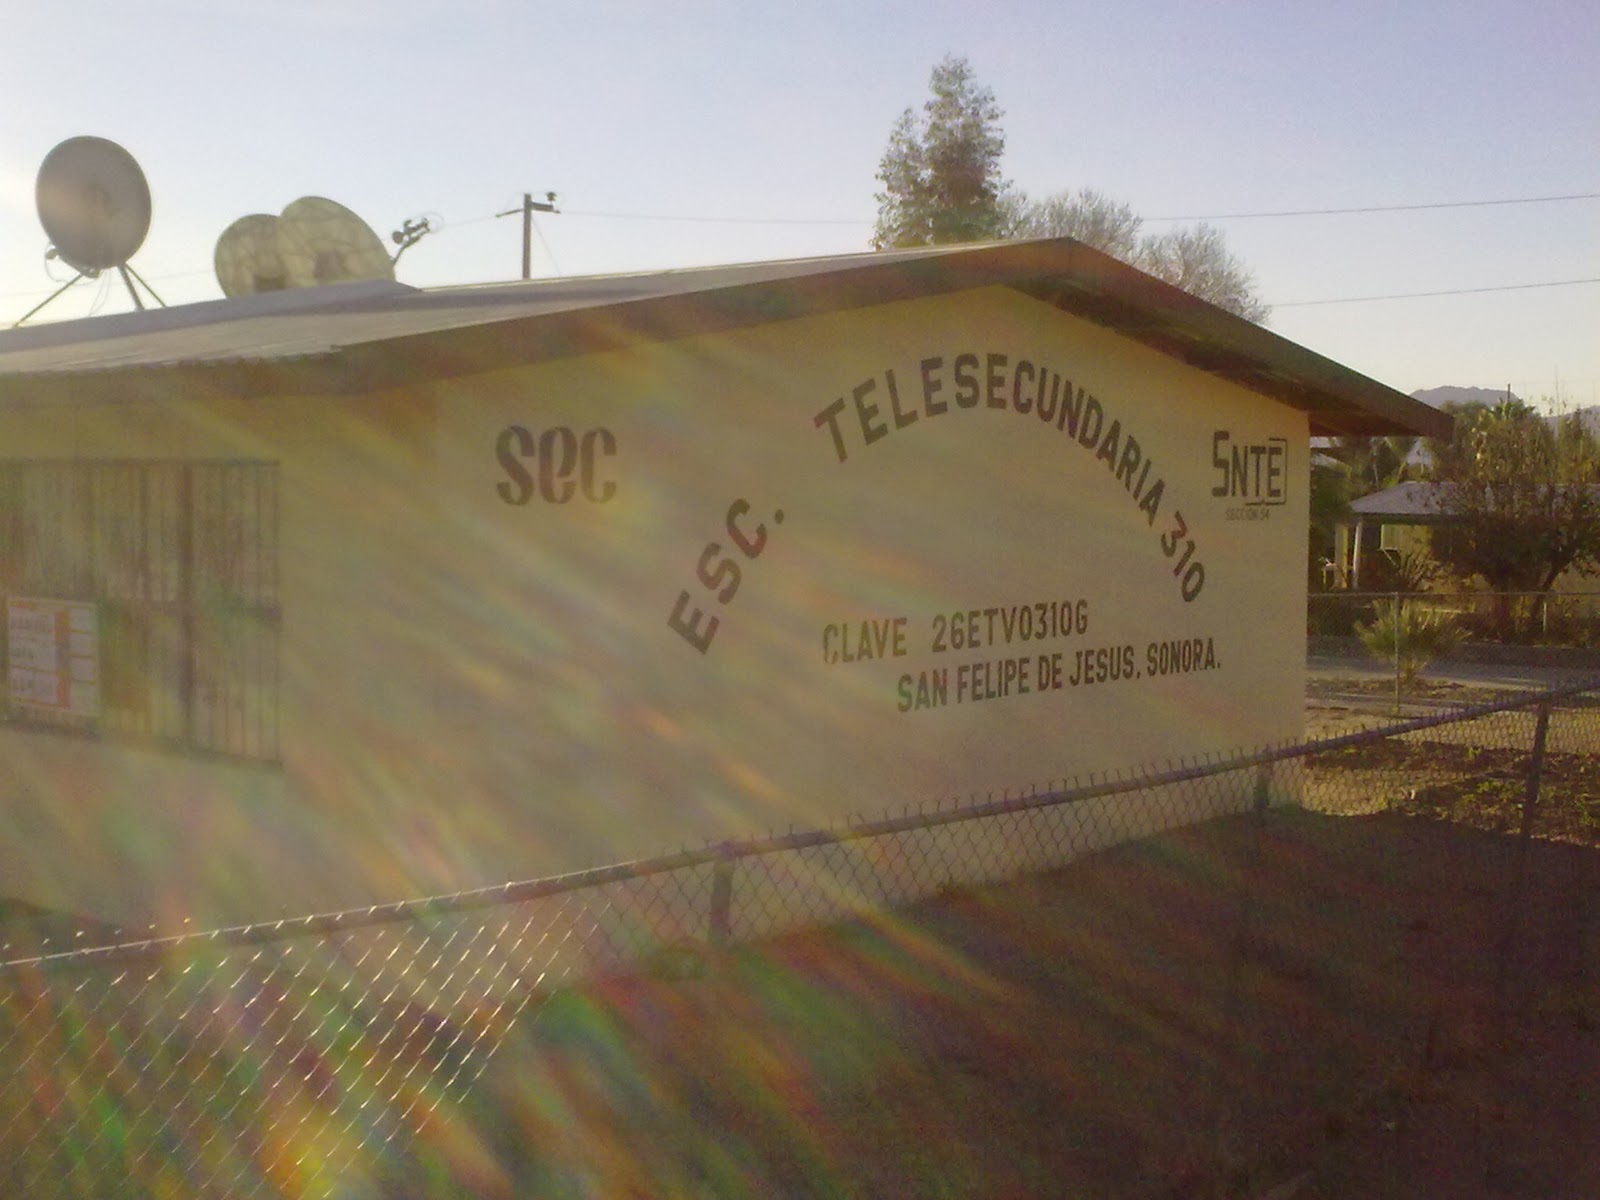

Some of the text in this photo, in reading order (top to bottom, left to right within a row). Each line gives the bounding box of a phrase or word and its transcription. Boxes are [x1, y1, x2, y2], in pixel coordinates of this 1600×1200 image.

[1212, 430, 1282, 497] SNTE
[667, 353, 1205, 654] ESC. TELESECUNDARIA 310
[823, 600, 1088, 664] CLAVE 26ETV0310G
[897, 667, 948, 713] SAN
[957, 657, 1030, 703] FELIPE
[1039, 653, 1062, 691] DE
[1147, 638, 1221, 676] SONORA.
